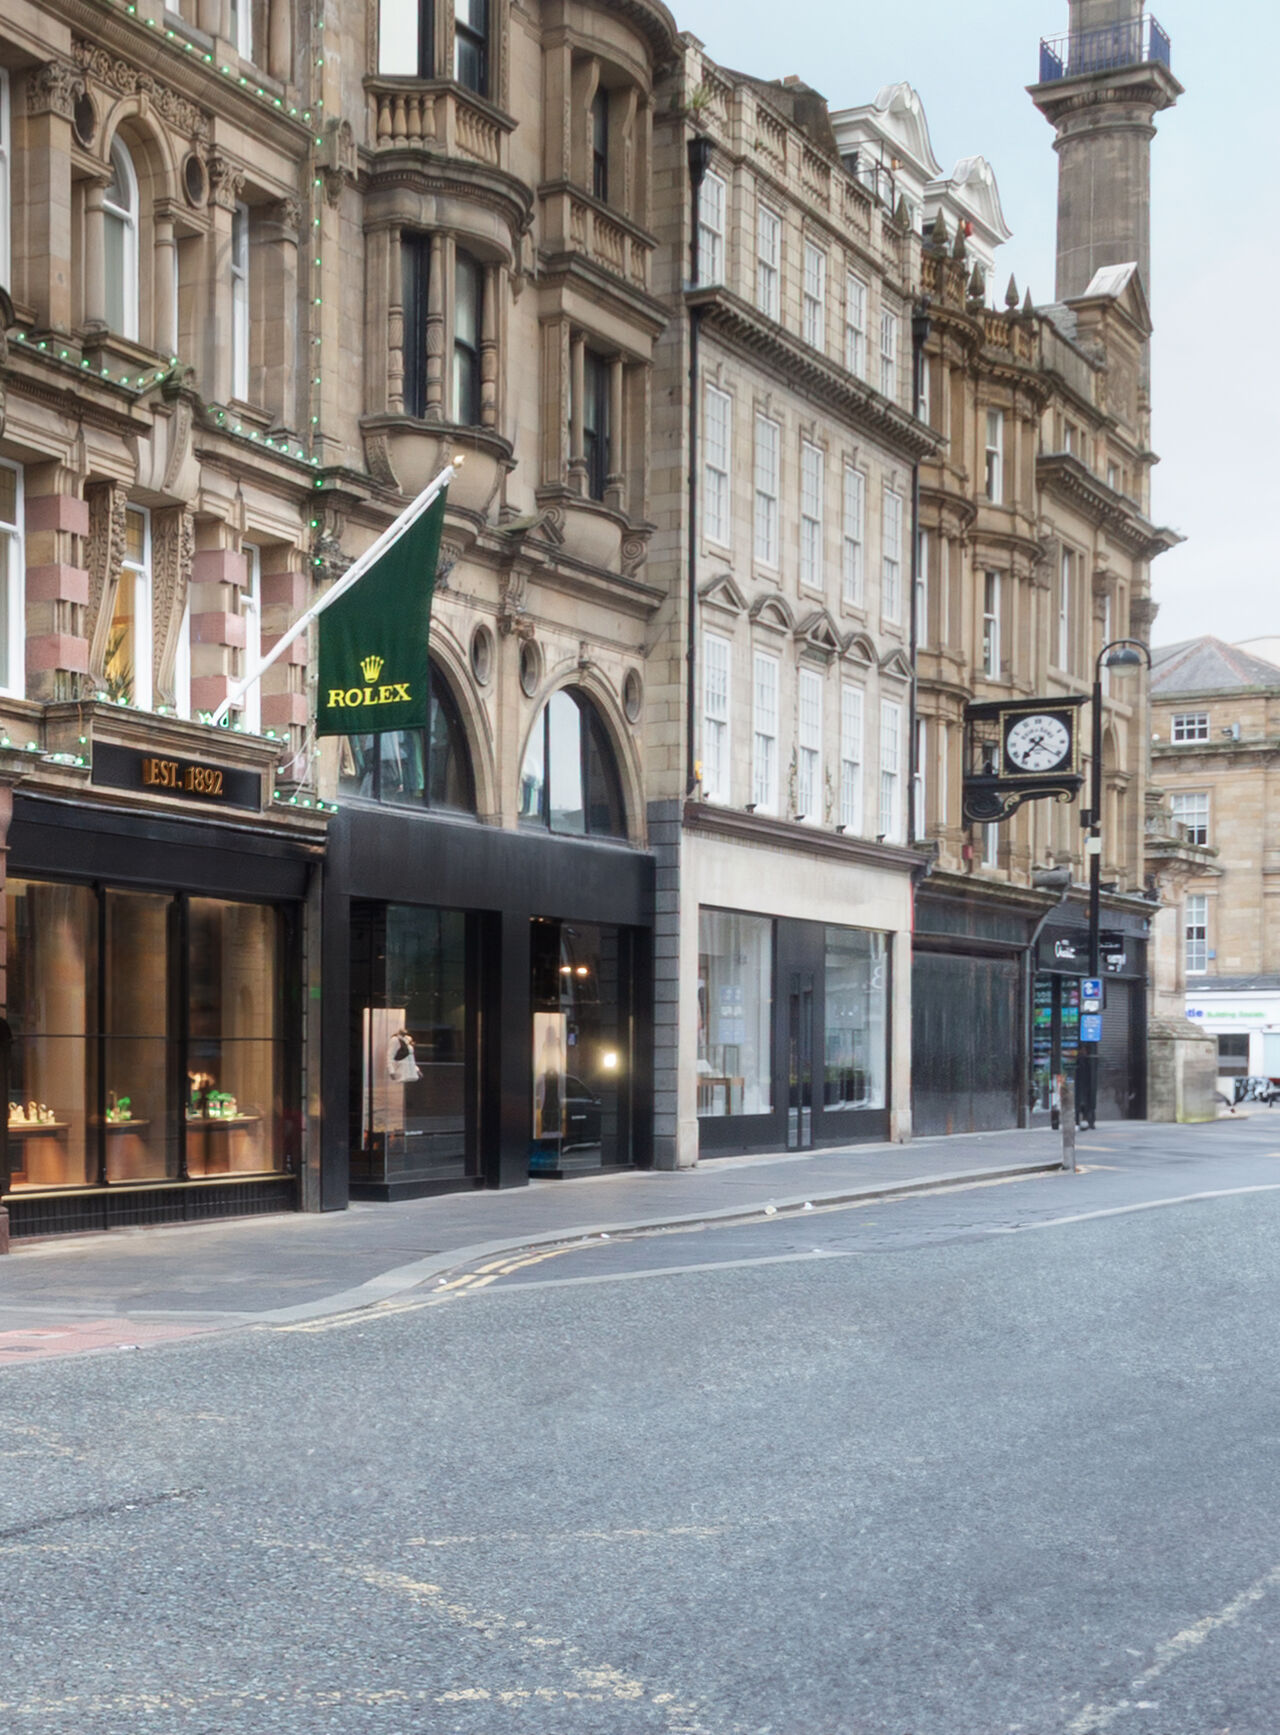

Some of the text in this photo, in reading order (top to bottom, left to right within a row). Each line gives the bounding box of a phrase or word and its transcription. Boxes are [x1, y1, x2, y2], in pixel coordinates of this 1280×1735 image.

[327, 683, 412, 707] ROLEX
[143, 758, 223, 795] EST. 1892
